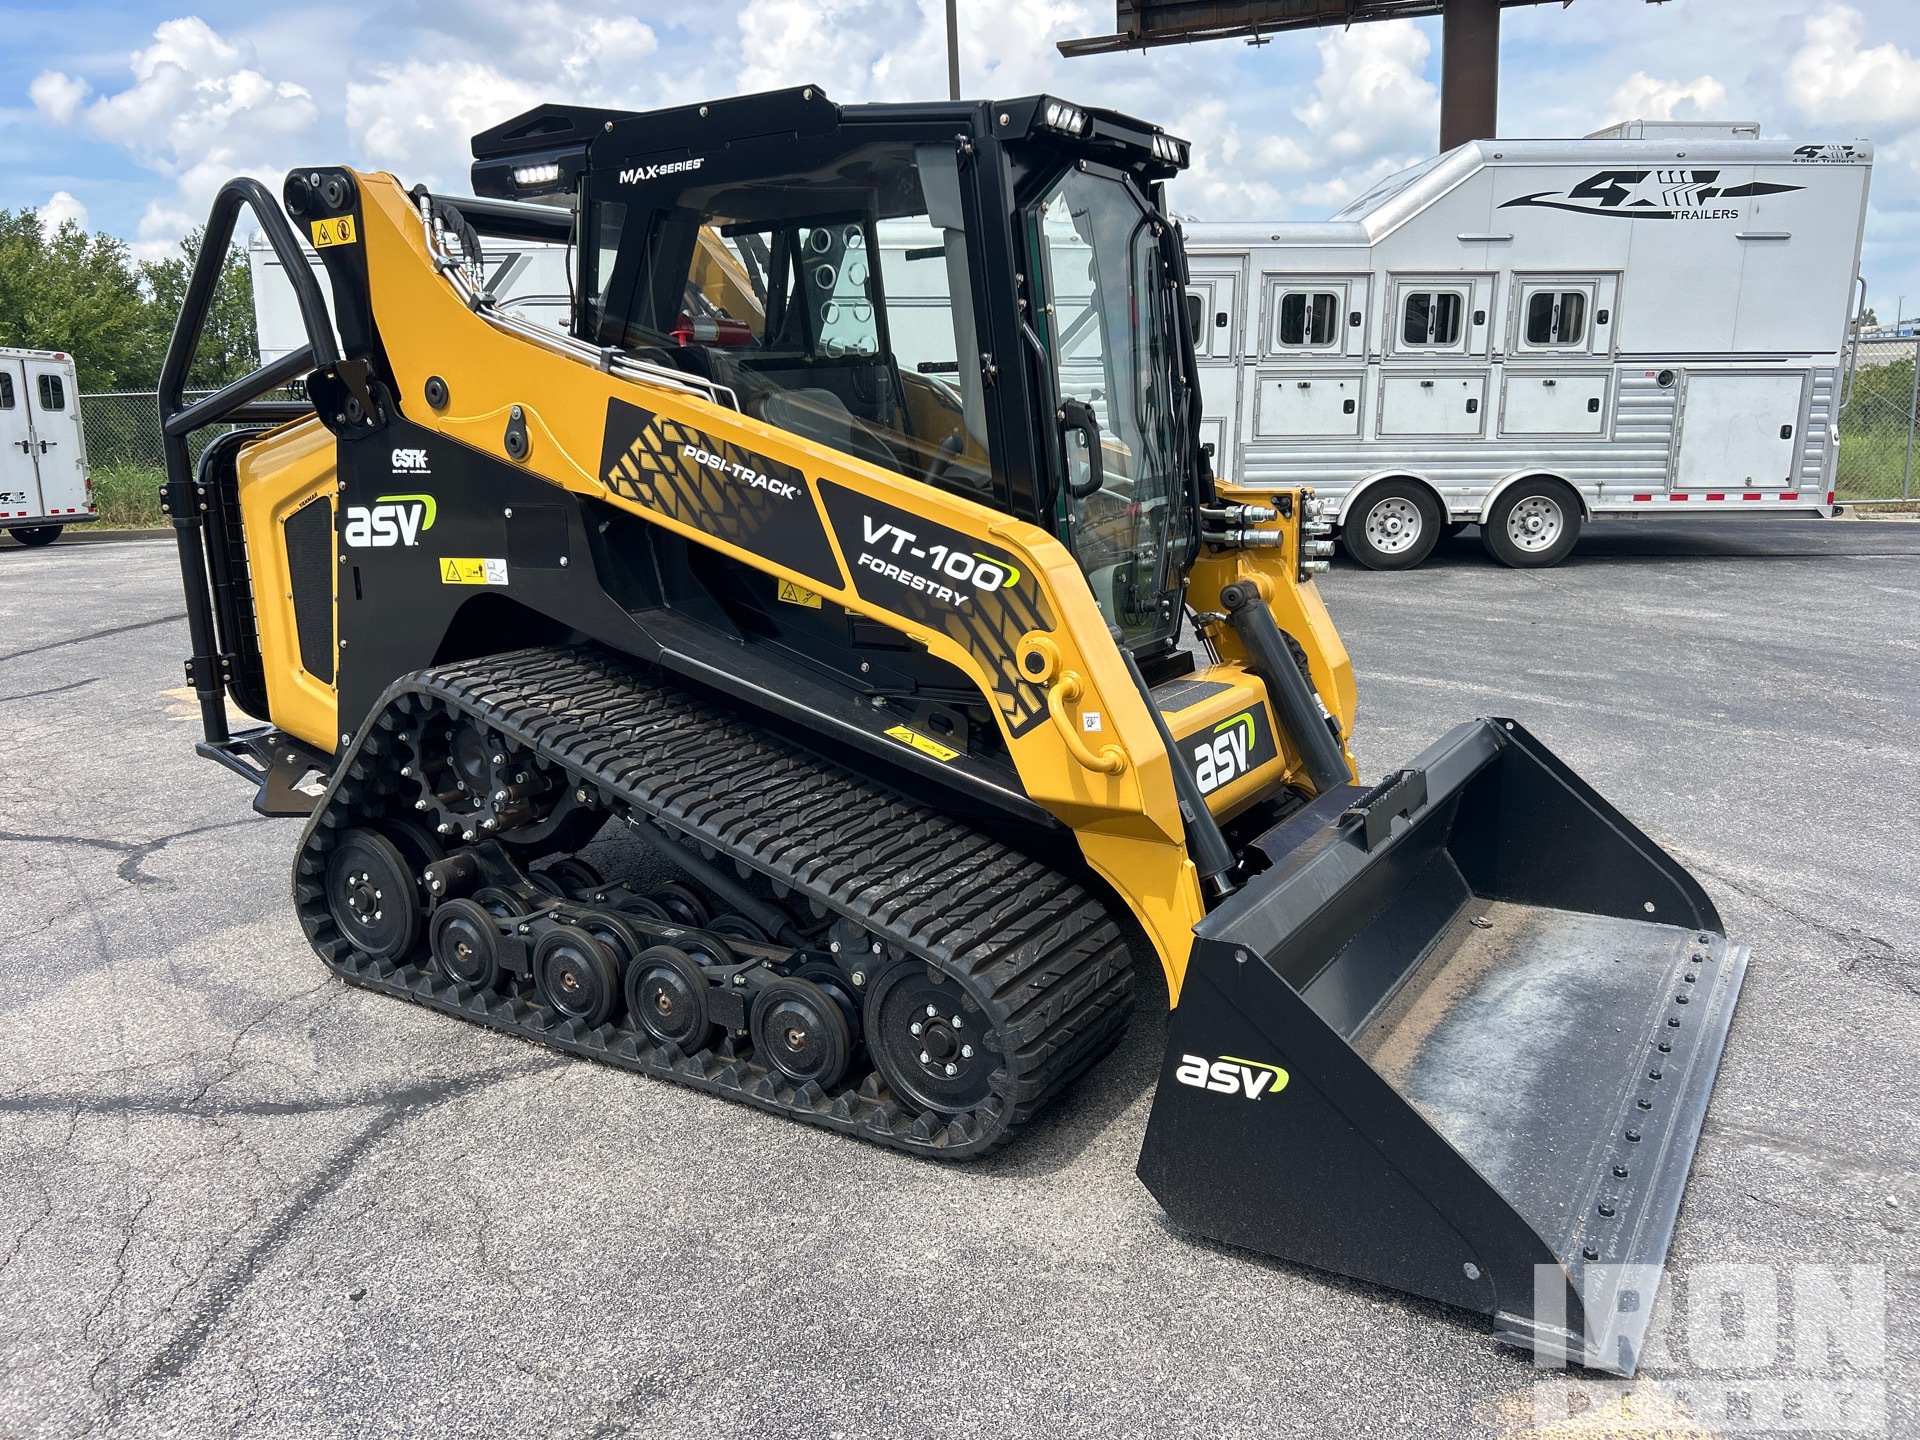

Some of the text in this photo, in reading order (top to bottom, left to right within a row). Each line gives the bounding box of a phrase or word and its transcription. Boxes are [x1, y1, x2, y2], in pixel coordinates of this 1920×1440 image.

[1672, 209, 1739, 220] TRAILERS
[299, 492, 318, 507] YANMAR
[863, 515, 1004, 592] VT-100
[857, 552, 969, 607] FORESTRY
